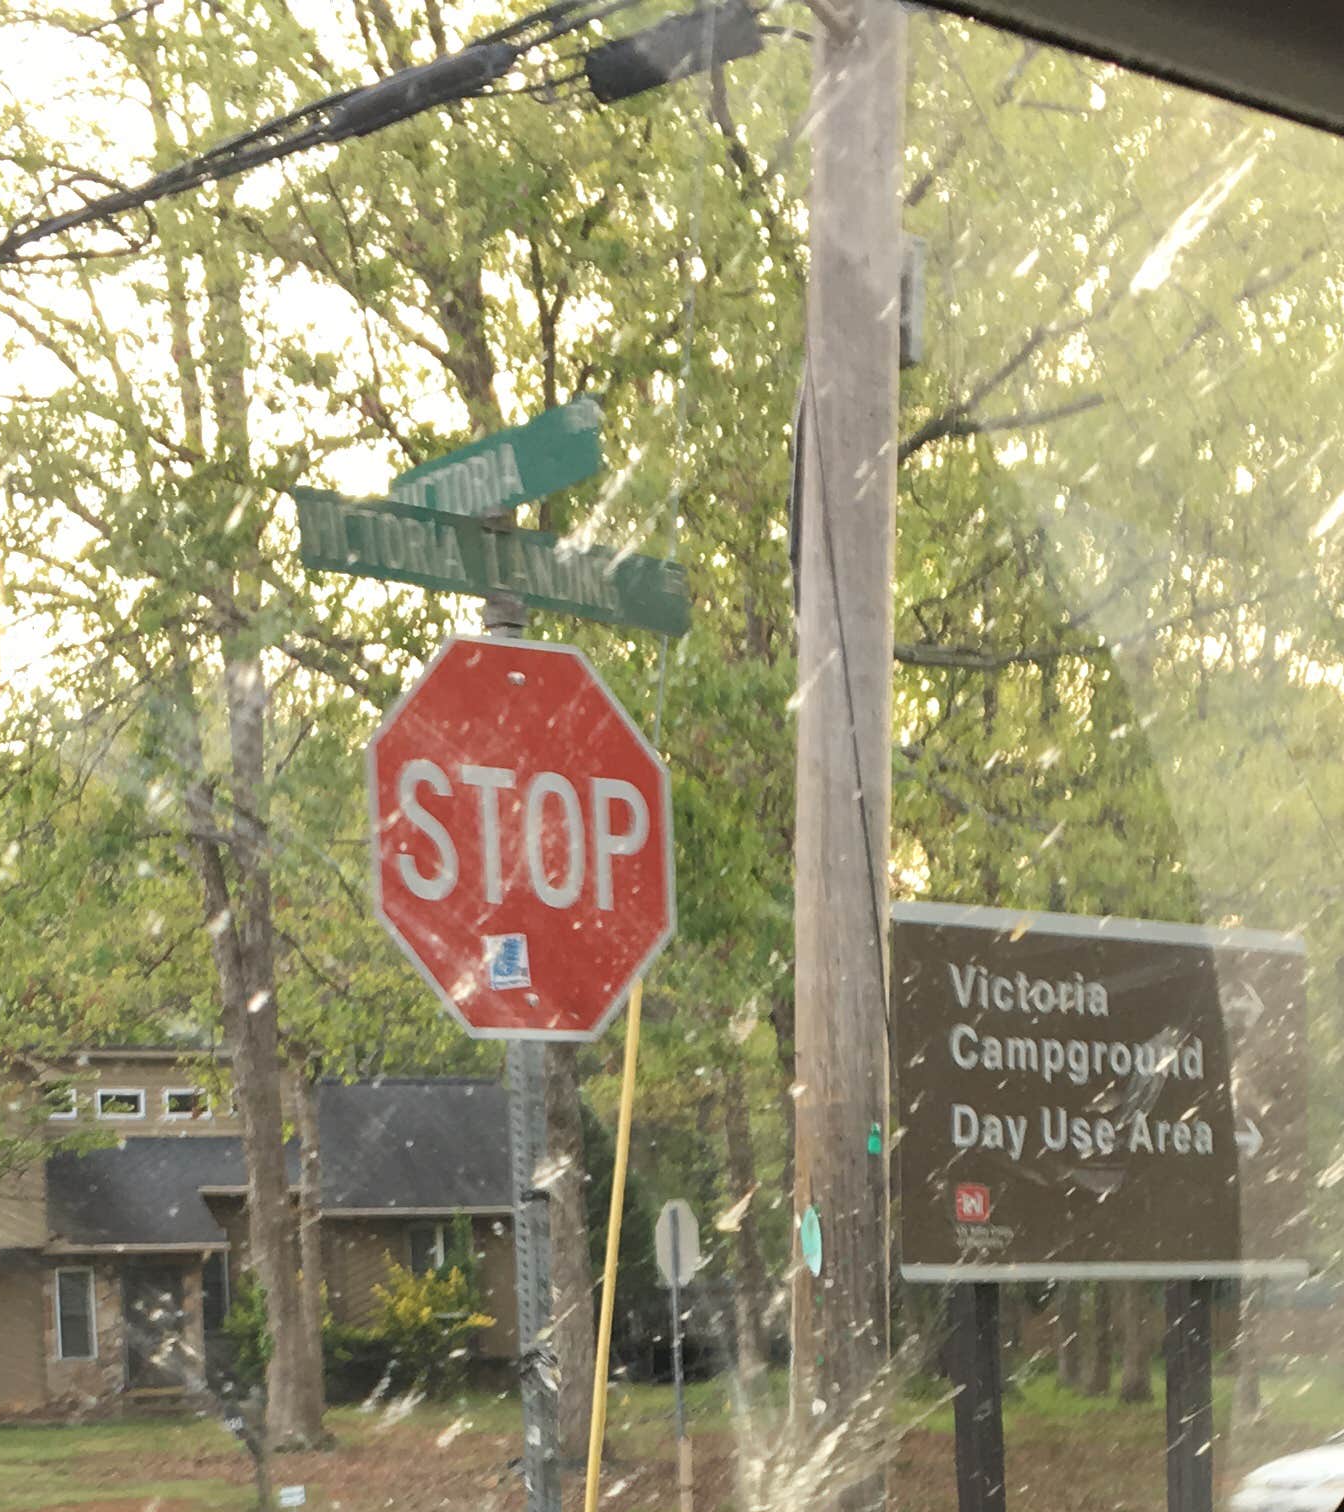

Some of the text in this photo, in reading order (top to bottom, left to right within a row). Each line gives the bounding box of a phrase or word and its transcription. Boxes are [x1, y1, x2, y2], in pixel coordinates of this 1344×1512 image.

[396, 758, 650, 912] STOP
[949, 962, 1110, 1017] Victoria
[949, 1024, 1204, 1085] Campground
[951, 1103, 1214, 1160] Day Use Area
